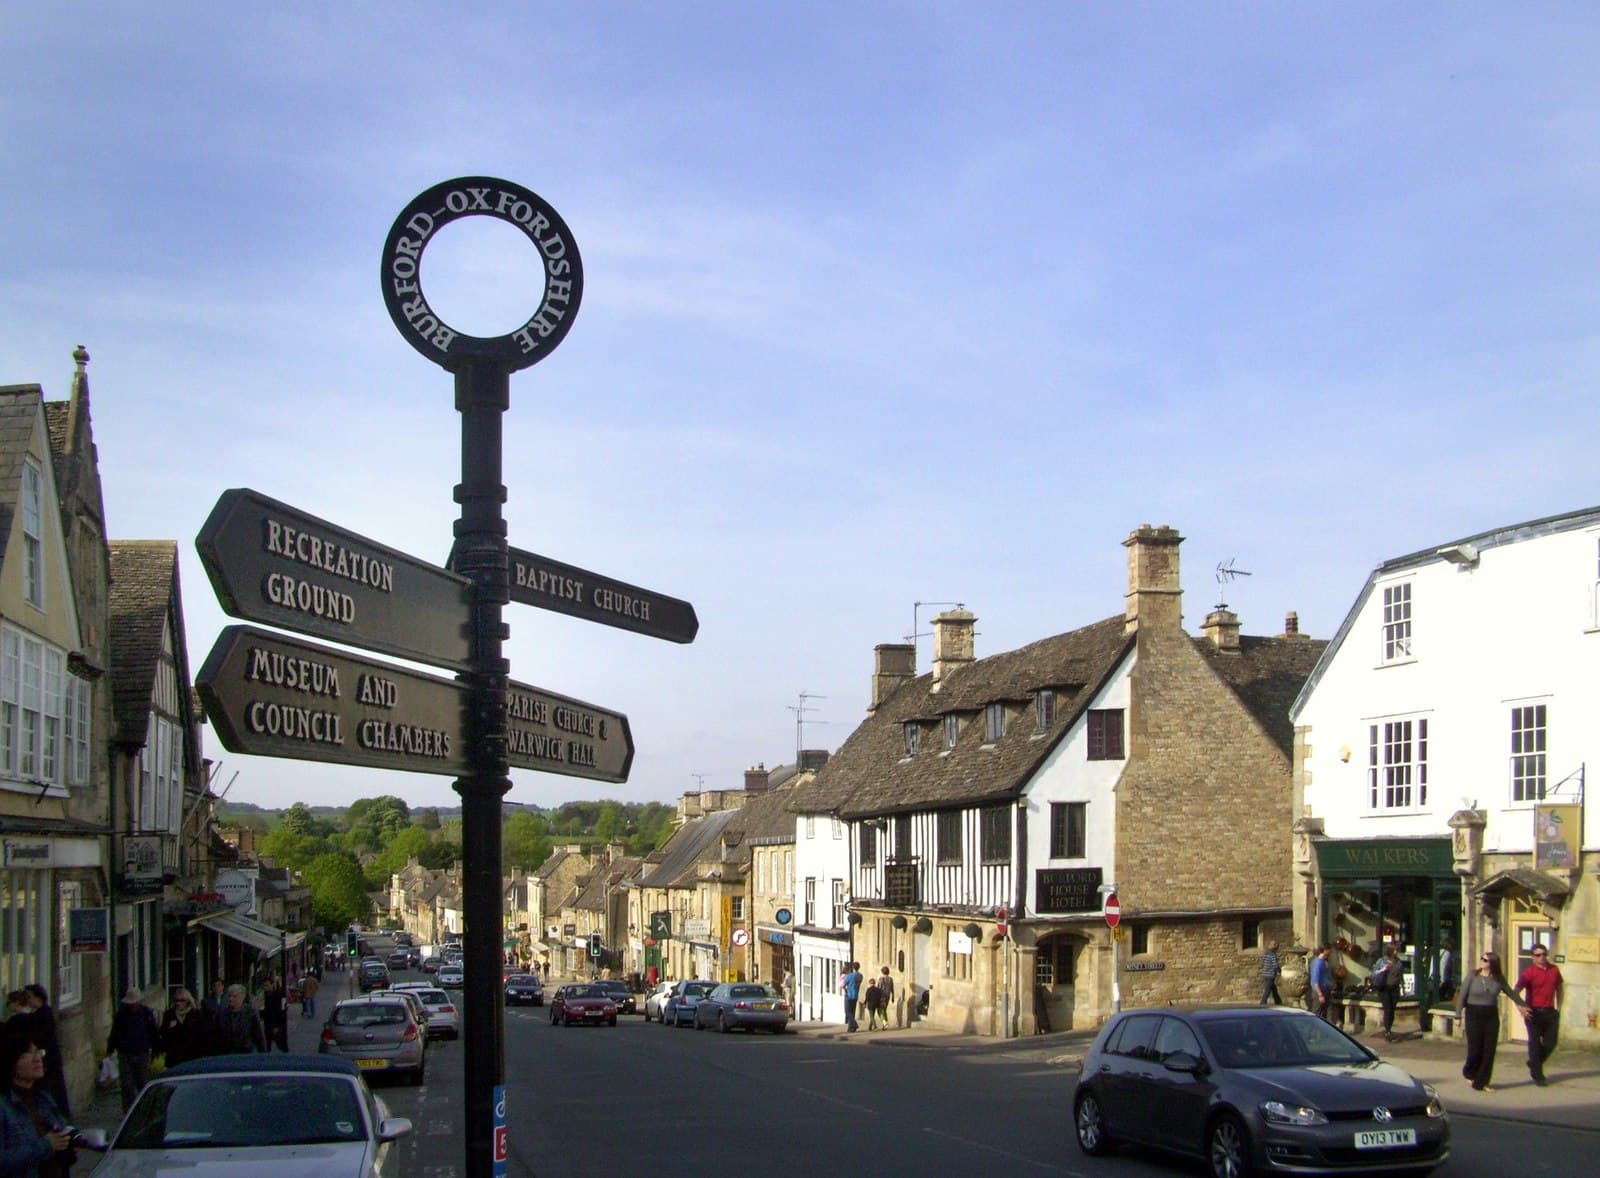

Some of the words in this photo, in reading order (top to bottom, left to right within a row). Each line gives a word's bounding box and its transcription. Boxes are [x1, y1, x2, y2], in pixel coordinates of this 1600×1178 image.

[267, 519, 393, 592] RECREATION
[267, 572, 355, 624] GROUND
[515, 562, 584, 602] BAPTIST
[593, 588, 650, 621] CHURCH
[251, 648, 341, 697] MUSEUM
[360, 674, 398, 708] AND
[251, 702, 345, 744] COUNCIL
[361, 719, 450, 758] CHAMBERS
[507, 692, 548, 724] PARISH
[556, 708, 595, 737] CHURCH
[507, 729, 565, 761] WARWICK
[570, 742, 597, 766] HALL
[1345, 847, 1430, 864] WALKERS
[1049, 884, 1089, 896] HOUSE
[1049, 896, 1087, 909] HOTEL
